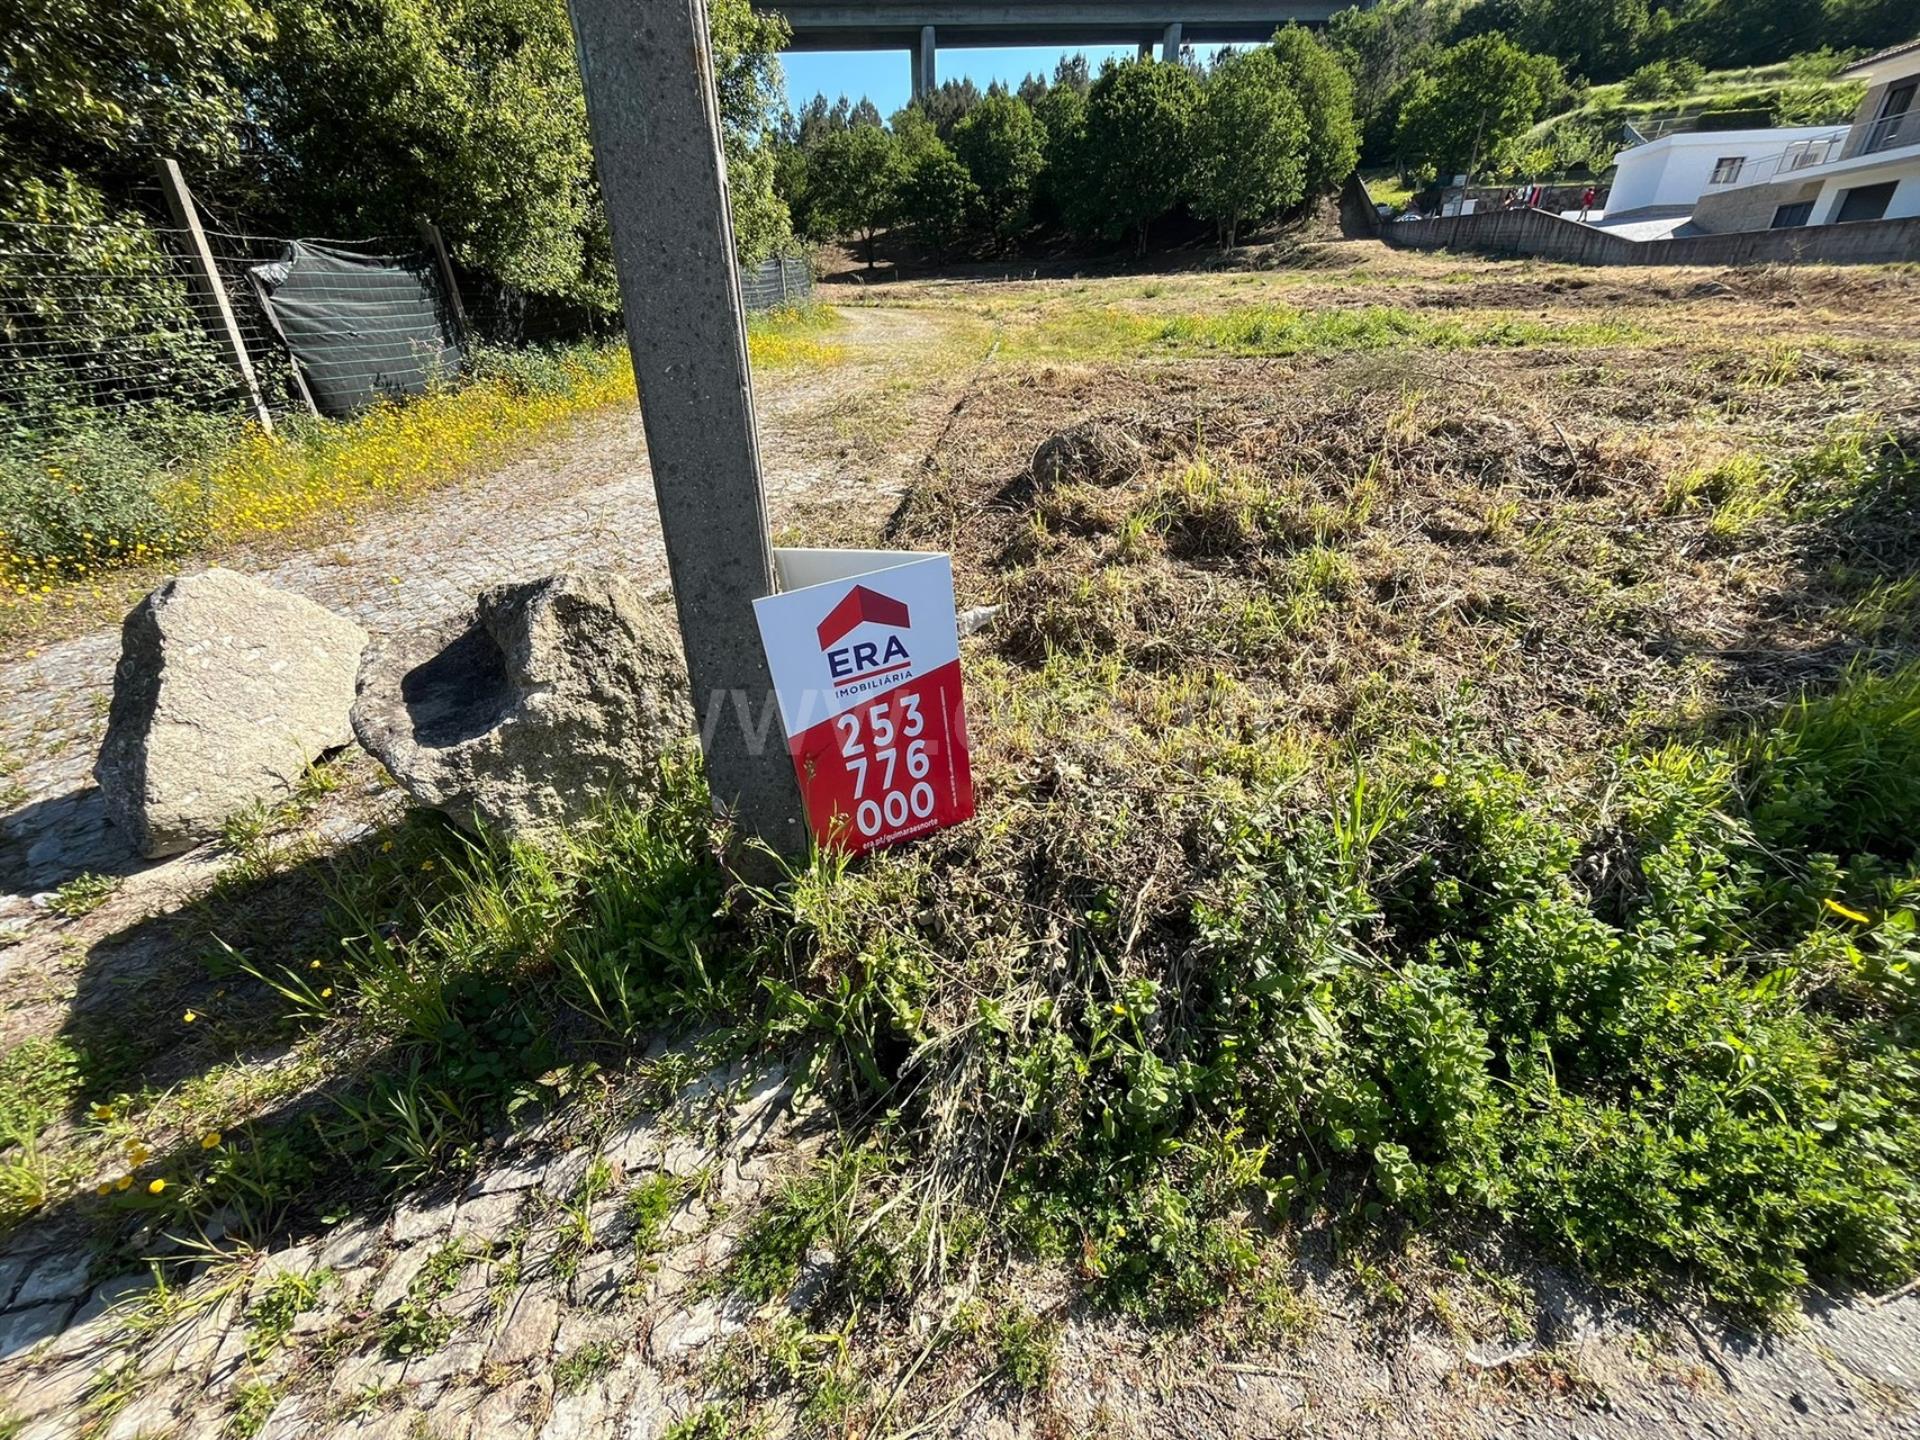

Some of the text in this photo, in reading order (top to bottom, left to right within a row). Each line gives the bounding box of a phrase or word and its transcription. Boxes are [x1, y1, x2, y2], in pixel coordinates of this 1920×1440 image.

[828, 635, 909, 677] ERA
[836, 670, 912, 698] IMOBILIÁRIA
[837, 693, 924, 758] 253
[846, 740, 930, 799] 776
[857, 781, 935, 836] 000
[862, 818, 938, 849] era.pt/guimaraesnorte
